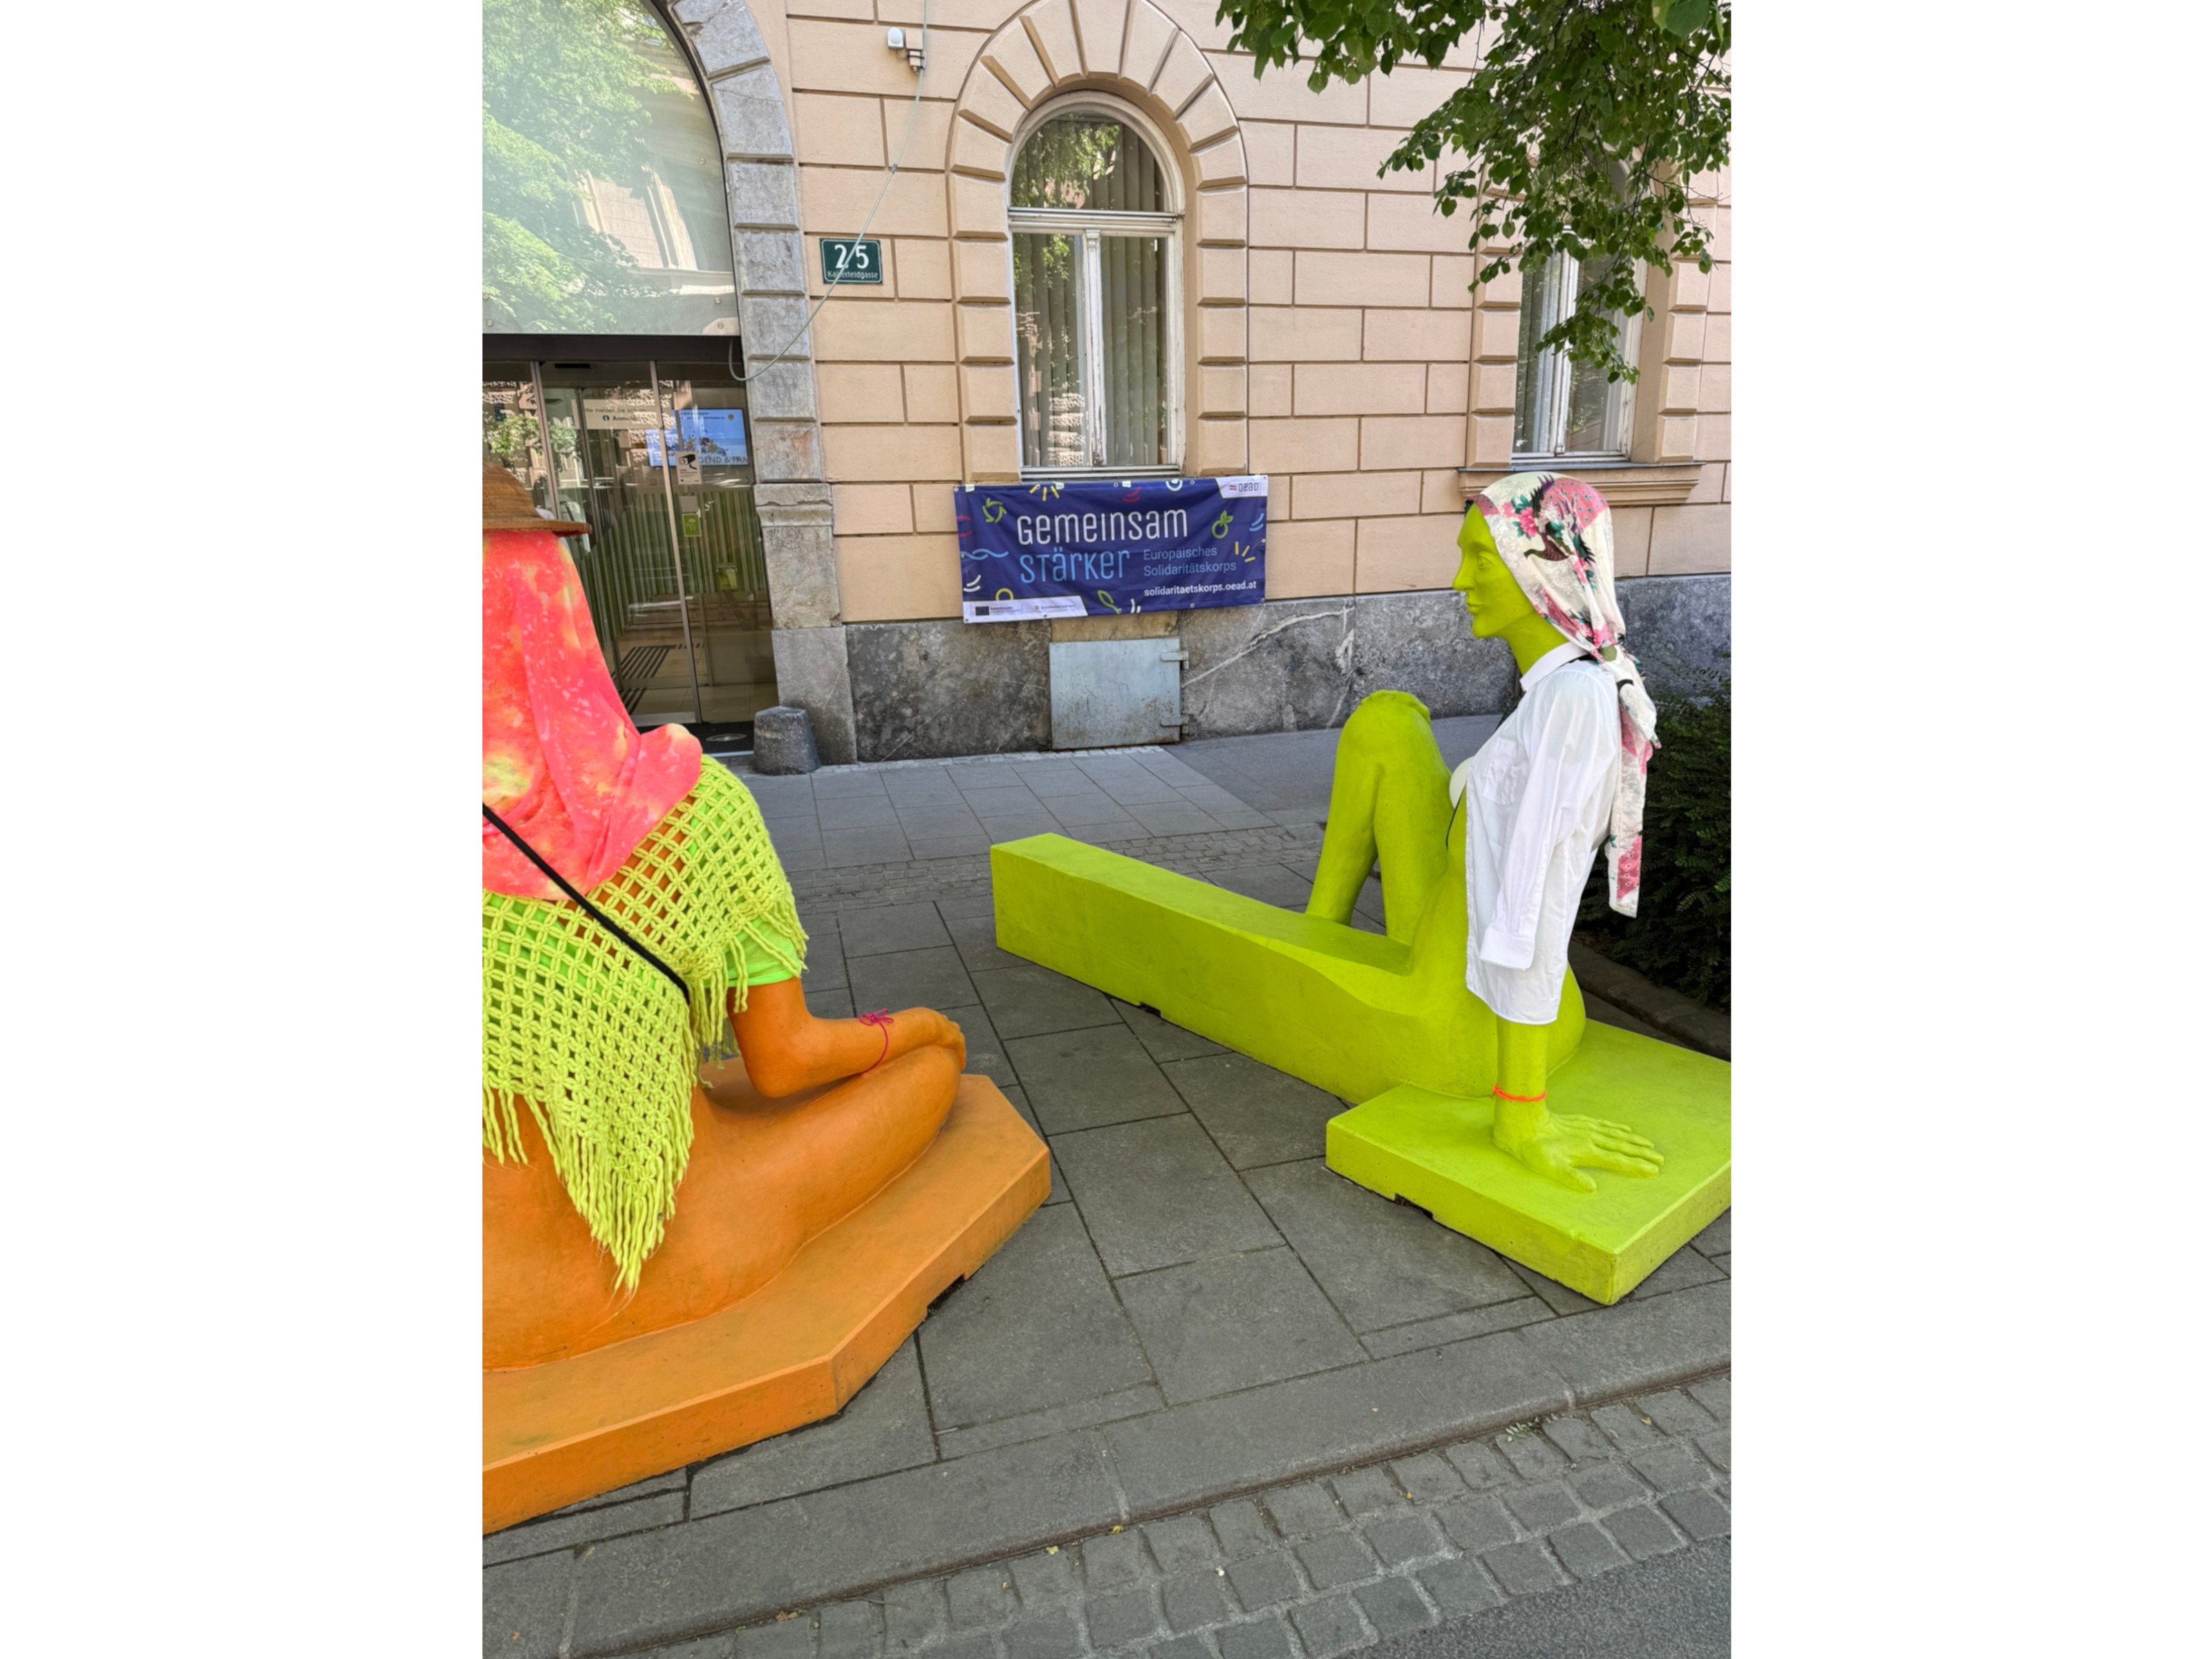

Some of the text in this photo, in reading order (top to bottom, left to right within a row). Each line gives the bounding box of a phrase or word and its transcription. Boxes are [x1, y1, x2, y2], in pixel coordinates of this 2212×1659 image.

[834, 243, 870, 270] 25
[827, 270, 879, 280] Kaierfeldgasse
[1143, 545, 1218, 561] Europäisches
[1143, 561, 1237, 577] Solidaritätskorps
[1143, 580, 1257, 597] solidaritaetskorps.oead.at
